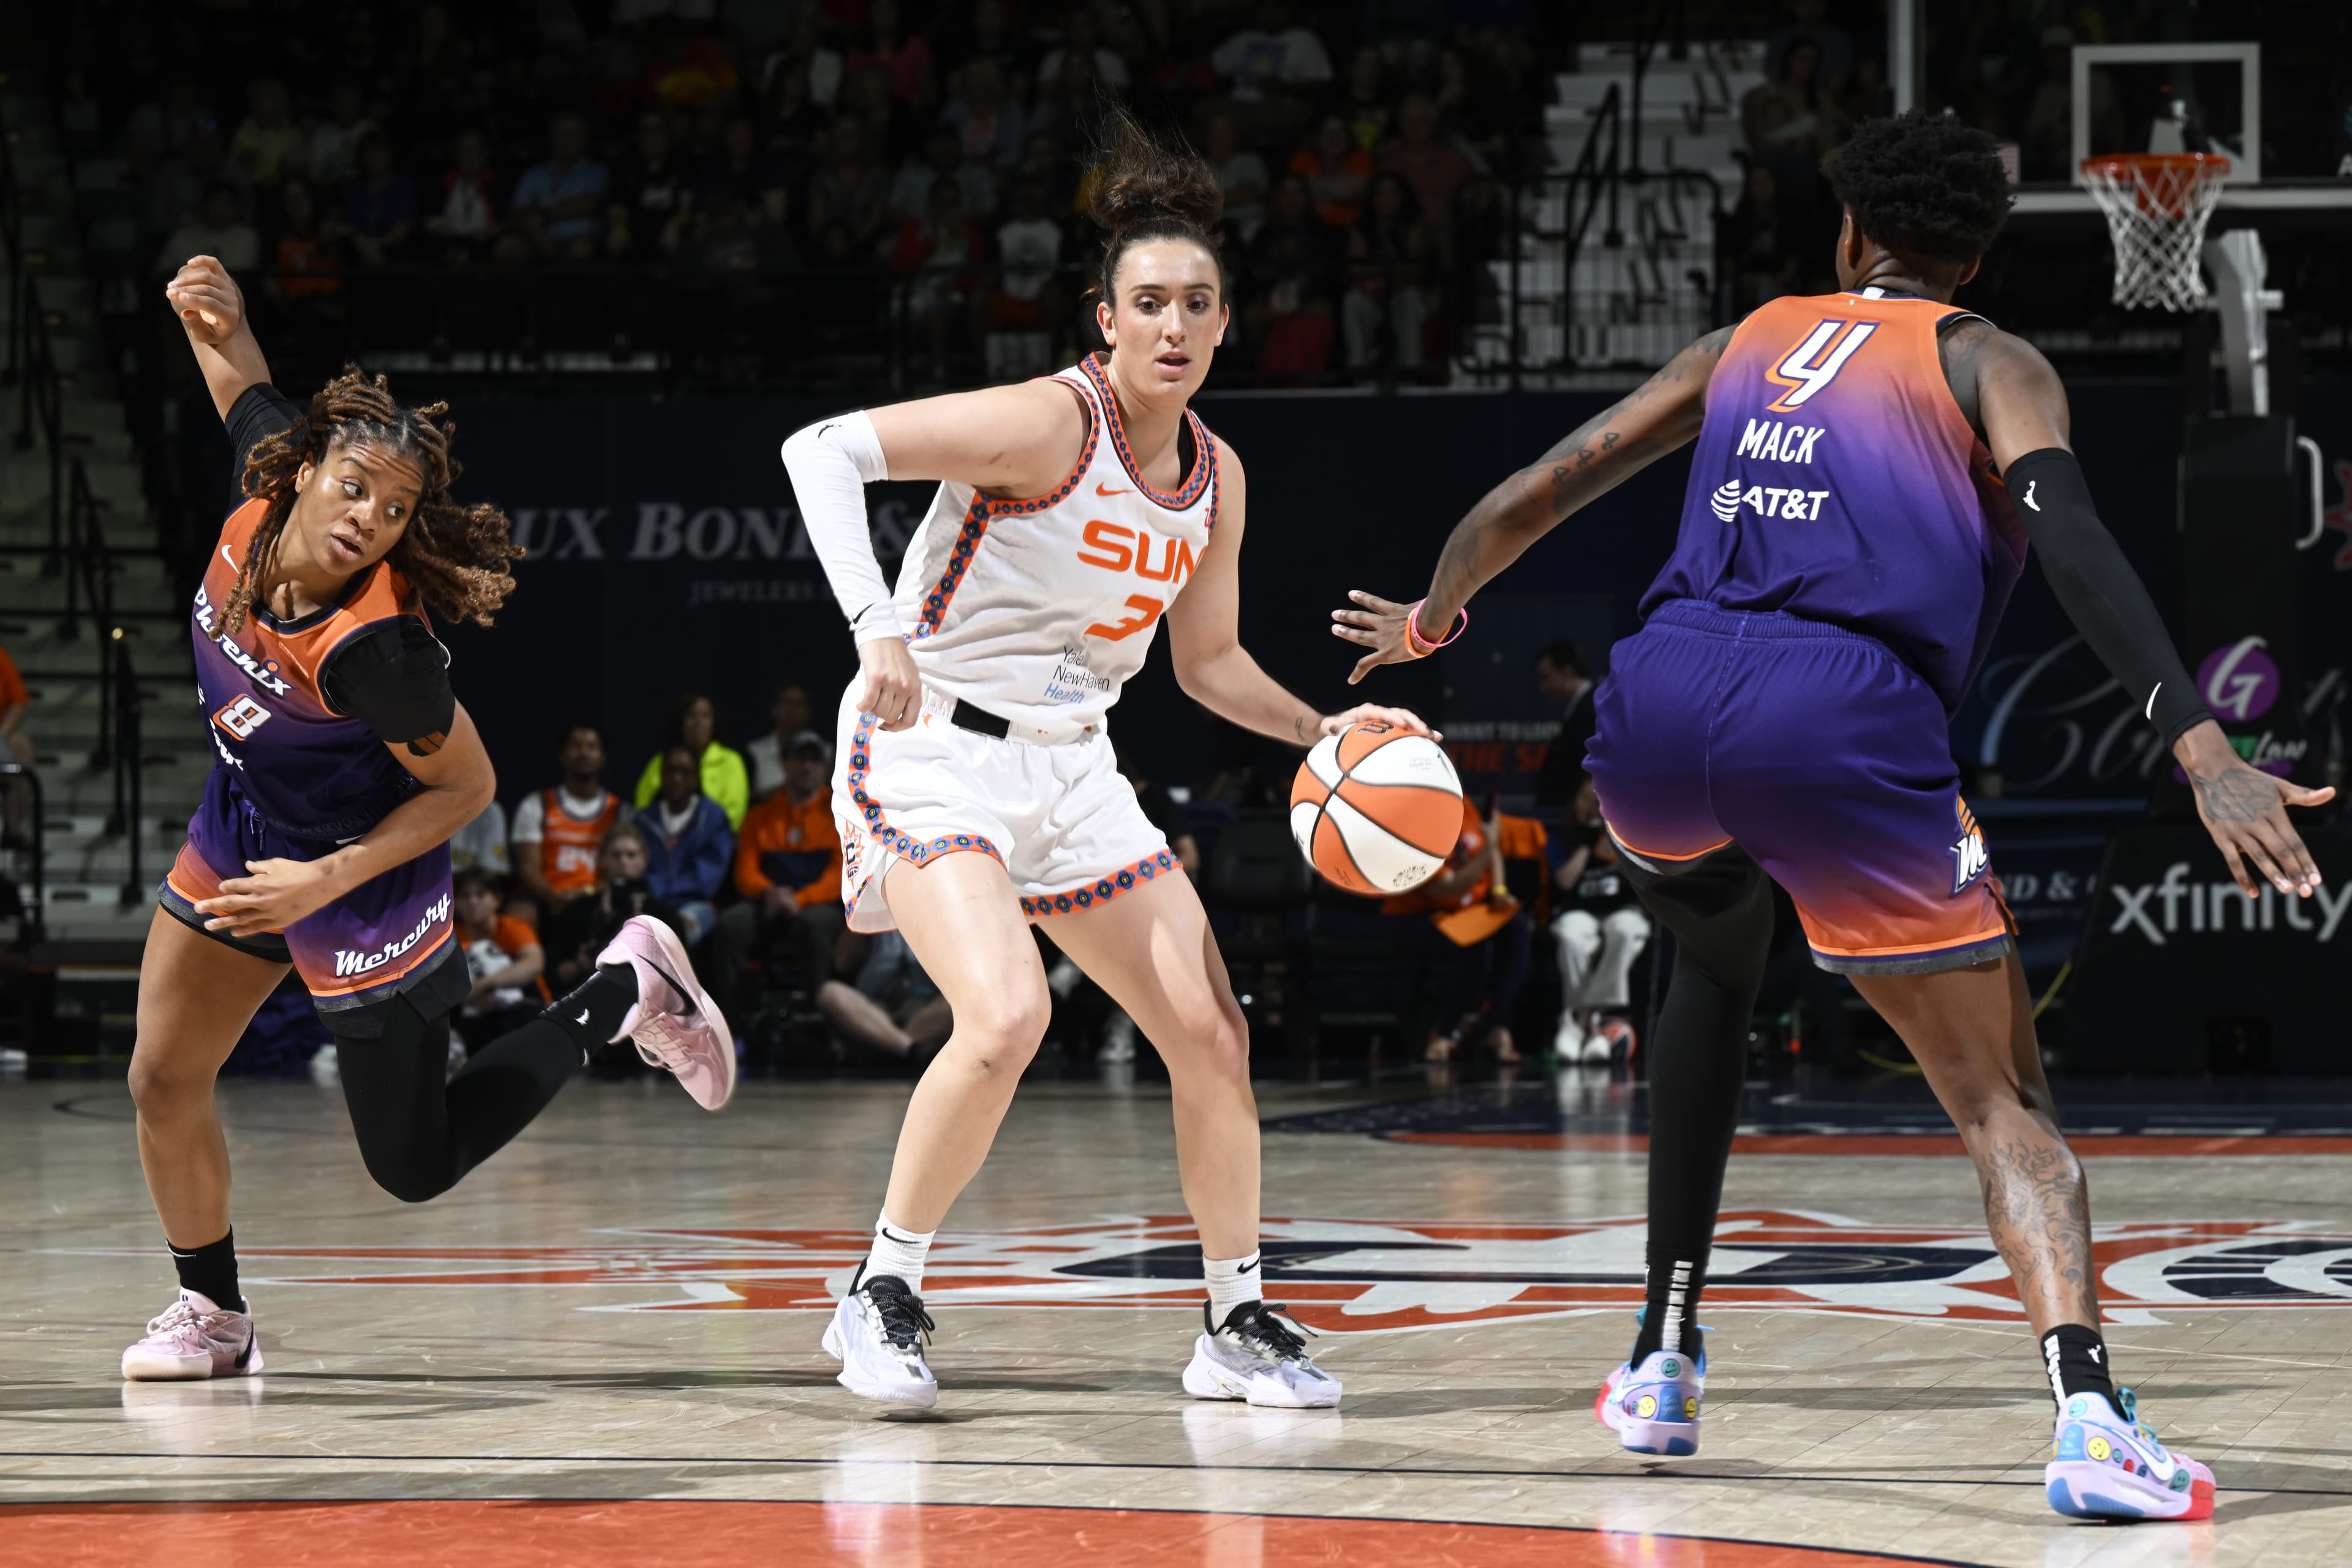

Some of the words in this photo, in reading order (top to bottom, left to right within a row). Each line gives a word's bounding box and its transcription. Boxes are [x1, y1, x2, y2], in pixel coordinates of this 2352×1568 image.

[1771, 318, 1881, 409] 4
[1736, 418, 1825, 464] MACK
[1741, 486, 1830, 521] AT&T
[513, 507, 609, 561] UX
[1077, 519, 1208, 584] SUN
[194, 581, 293, 697] Phenix
[1084, 594, 1164, 642] 3
[1053, 665, 1110, 691] NewHaven
[1063, 645, 1084, 666] Yale
[214, 693, 271, 741] 8
[1044, 682, 1085, 704] Health
[2109, 861, 2352, 946] xfinity
[335, 892, 451, 977] Mercury
